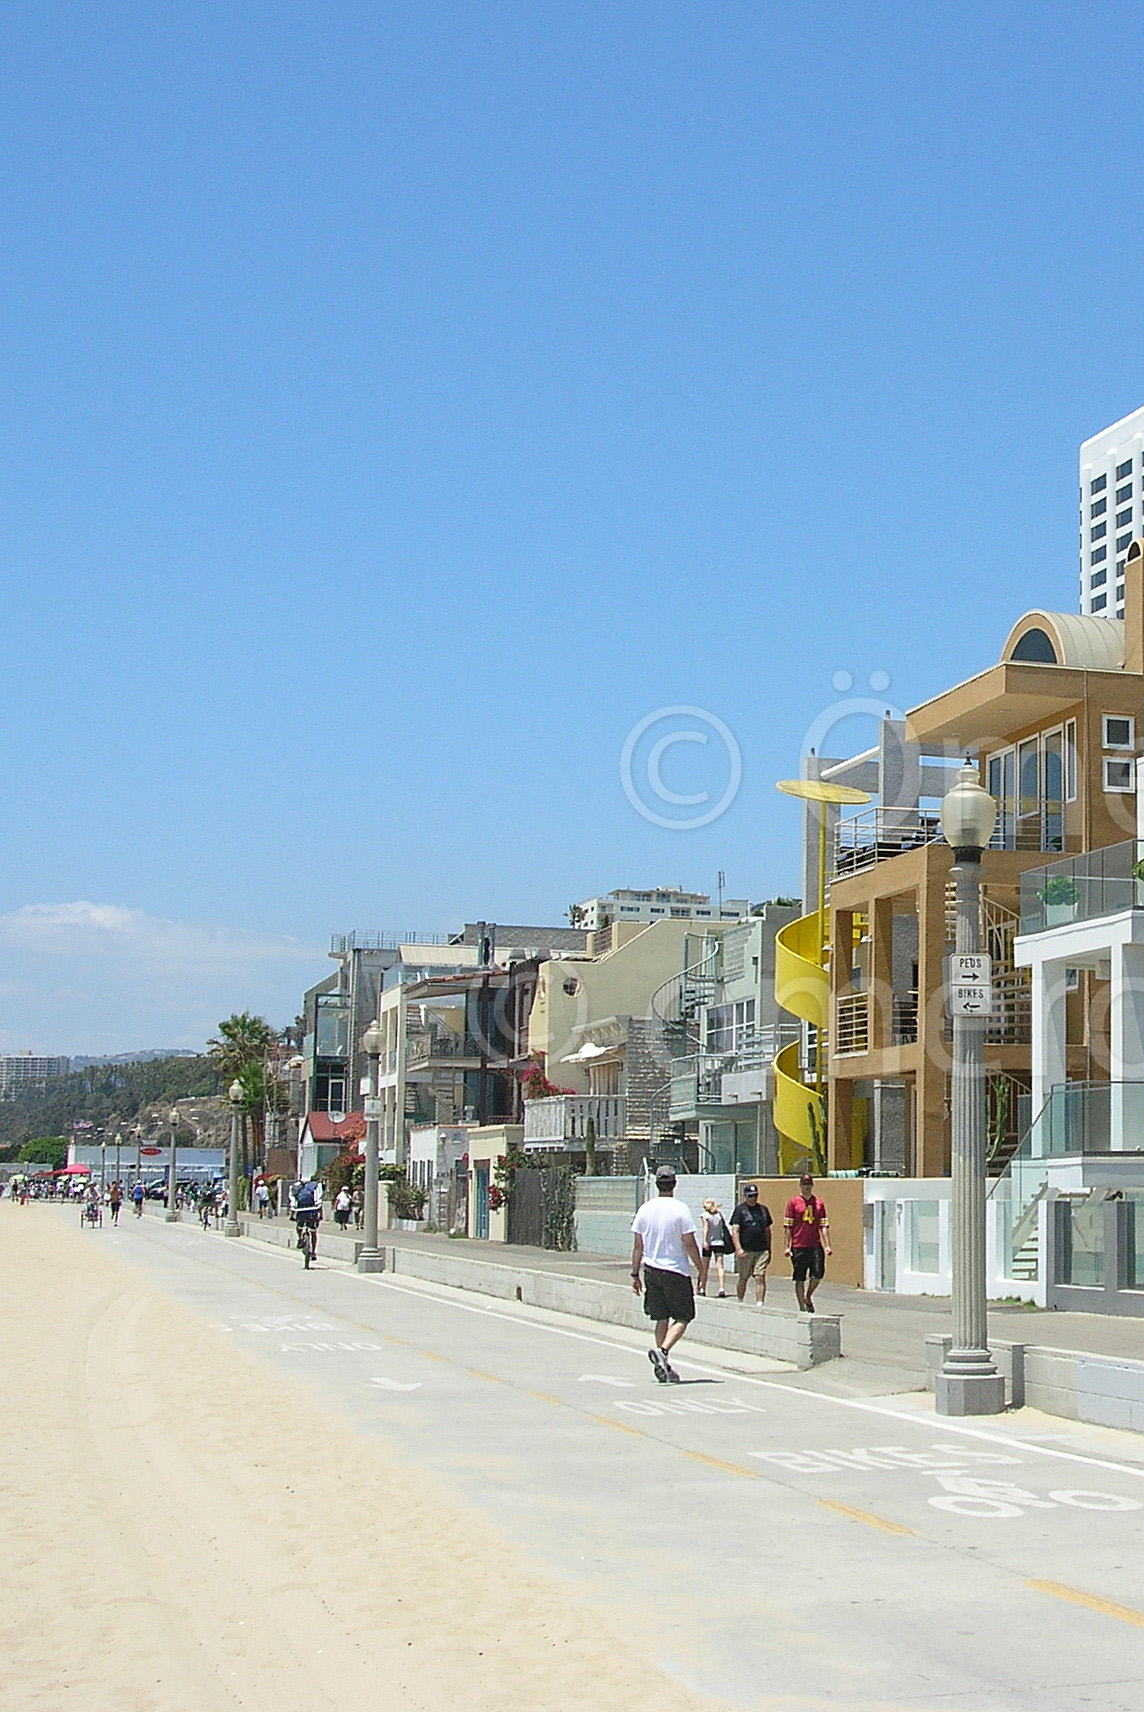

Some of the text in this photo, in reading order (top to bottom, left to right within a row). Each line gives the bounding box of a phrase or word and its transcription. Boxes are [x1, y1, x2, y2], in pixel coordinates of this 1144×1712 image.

[959, 957, 982, 968] PEDS
[957, 988, 984, 999] BIKES
[802, 1204, 815, 1225] 4
[612, 1397, 767, 1416] ONLY
[747, 1444, 1023, 1474] BIKES
